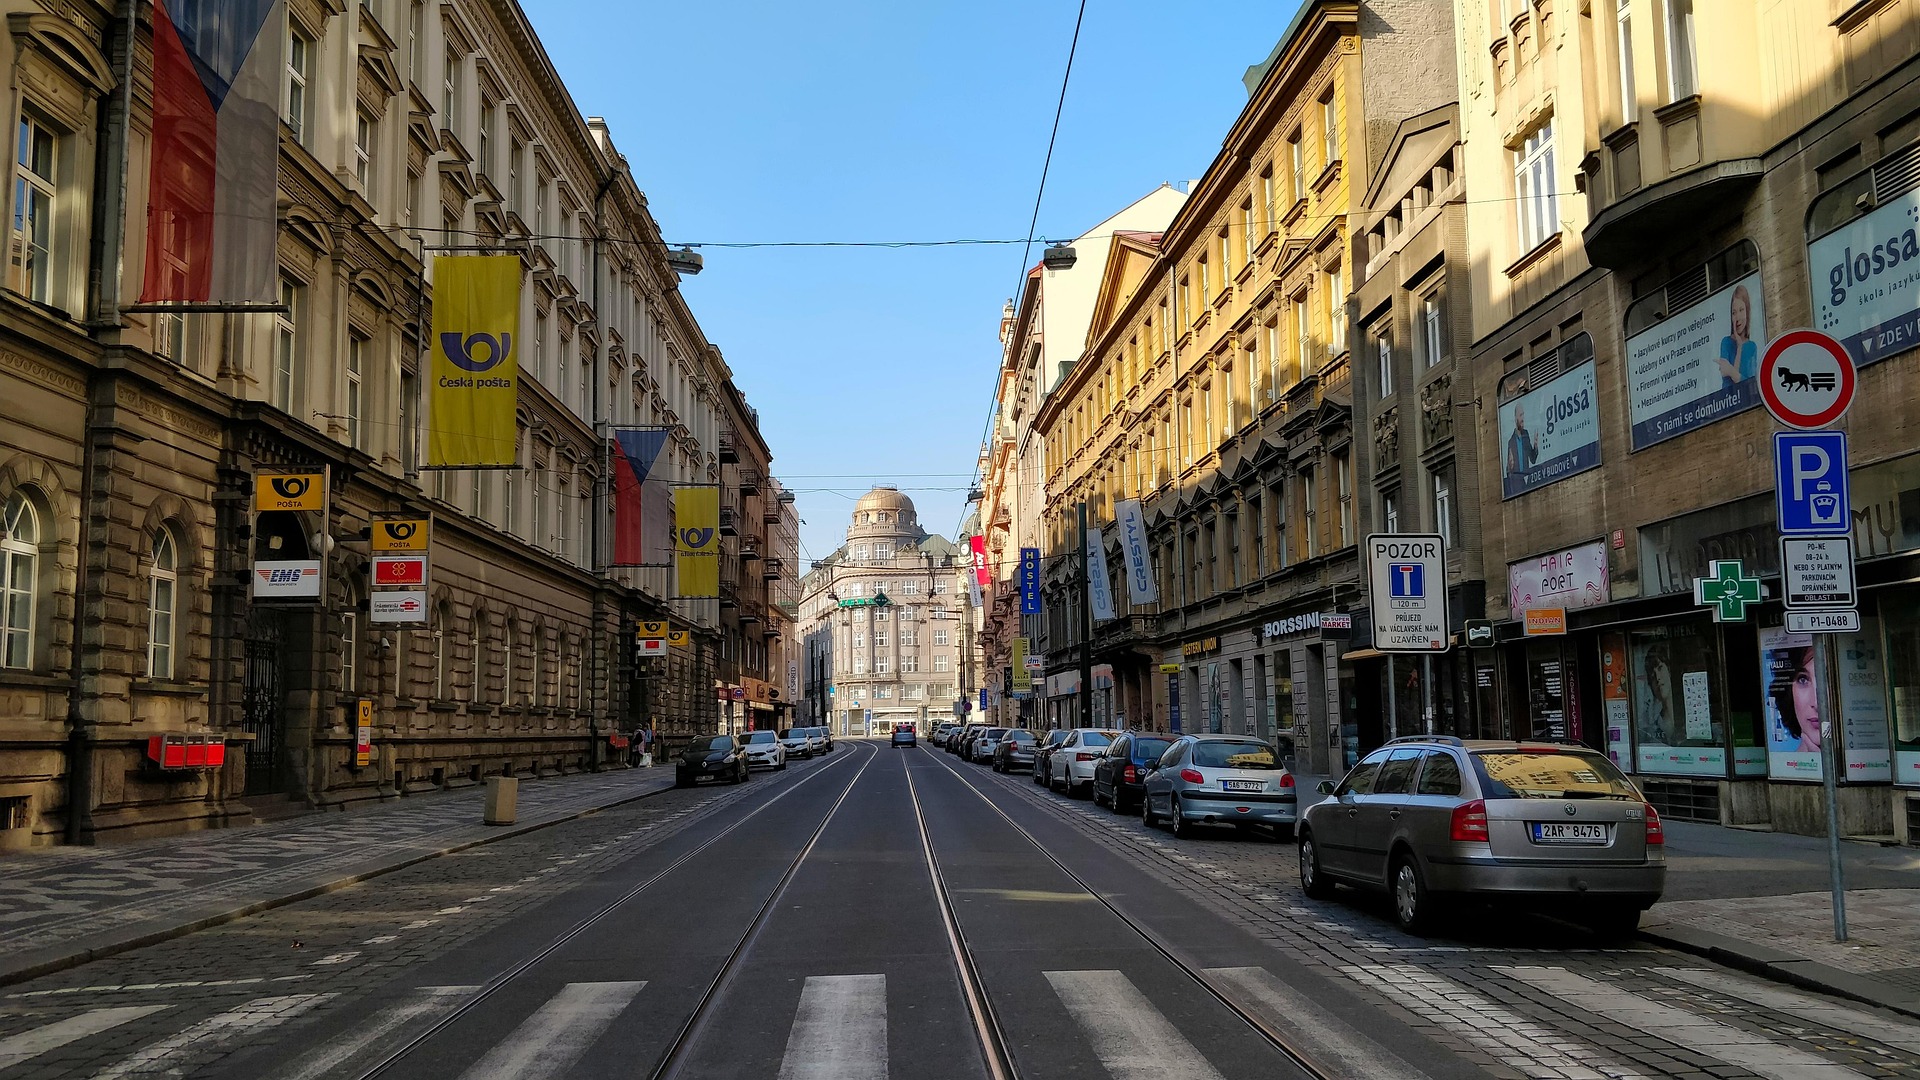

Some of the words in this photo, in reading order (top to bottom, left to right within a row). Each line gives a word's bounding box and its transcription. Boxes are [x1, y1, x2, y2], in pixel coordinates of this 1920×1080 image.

[1829, 228, 1919, 307] glossa
[1859, 288, 1884, 306] škola
[1637, 340, 1660, 358] Jazykové
[1661, 333, 1676, 345] kurzy
[1677, 328, 1687, 340] pro
[1687, 313, 1715, 332] veřejnost
[1878, 326, 1902, 349] ZDE
[1905, 321, 1914, 337] V
[1639, 361, 1658, 375] Učebny
[1658, 357, 1666, 366] 6x
[1670, 345, 1686, 360] Praze
[1692, 334, 1710, 348] metra
[439, 375, 474, 388] Česká
[477, 376, 510, 389] pošta
[1640, 376, 1660, 392] Firemní
[1677, 366, 1685, 374] na
[1686, 358, 1700, 371] míru
[1641, 388, 1674, 408] Mezinárodní
[1675, 378, 1698, 394] zkoušky
[1546, 389, 1589, 435] glossa
[1657, 420, 1662, 435] S
[1663, 413, 1682, 432] námi
[1684, 412, 1694, 424] se
[1695, 389, 1741, 420] domluvíte!
[1531, 471, 1541, 483] ZDE
[1542, 470, 1546, 479] V
[1546, 457, 1570, 477] BUDOVĚ
[1792, 445, 1830, 501] P
[277, 500, 302, 508] POŠTA
[1126, 511, 1147, 592] CRESTYL
[1376, 543, 1435, 559] POZOR
[1540, 552, 1573, 572] HAIR
[1818, 562, 1842, 571] PLATNÝM
[270, 569, 301, 582] EMS
[1026, 552, 1034, 610] HOSTEL
[1542, 573, 1573, 592] PORT
[1802, 572, 1836, 581] PARKOVACÍM
[1802, 583, 1837, 592] OPRÁVNĚNÍM
[1264, 611, 1320, 638] BORSSINI
[1395, 612, 1421, 622] PRŮJEZD
[1528, 617, 1560, 625] INDIAN
[1811, 616, 1848, 627] P1-0488
[1390, 623, 1422, 632] VÁCLAVSKÉ
[1202, 636, 1217, 651] UNION
[1391, 634, 1429, 643] UZAVŘEN
[1028, 656, 1039, 664] dm
[1544, 825, 1565, 837] 2AR
[1573, 825, 1601, 837] 8476
